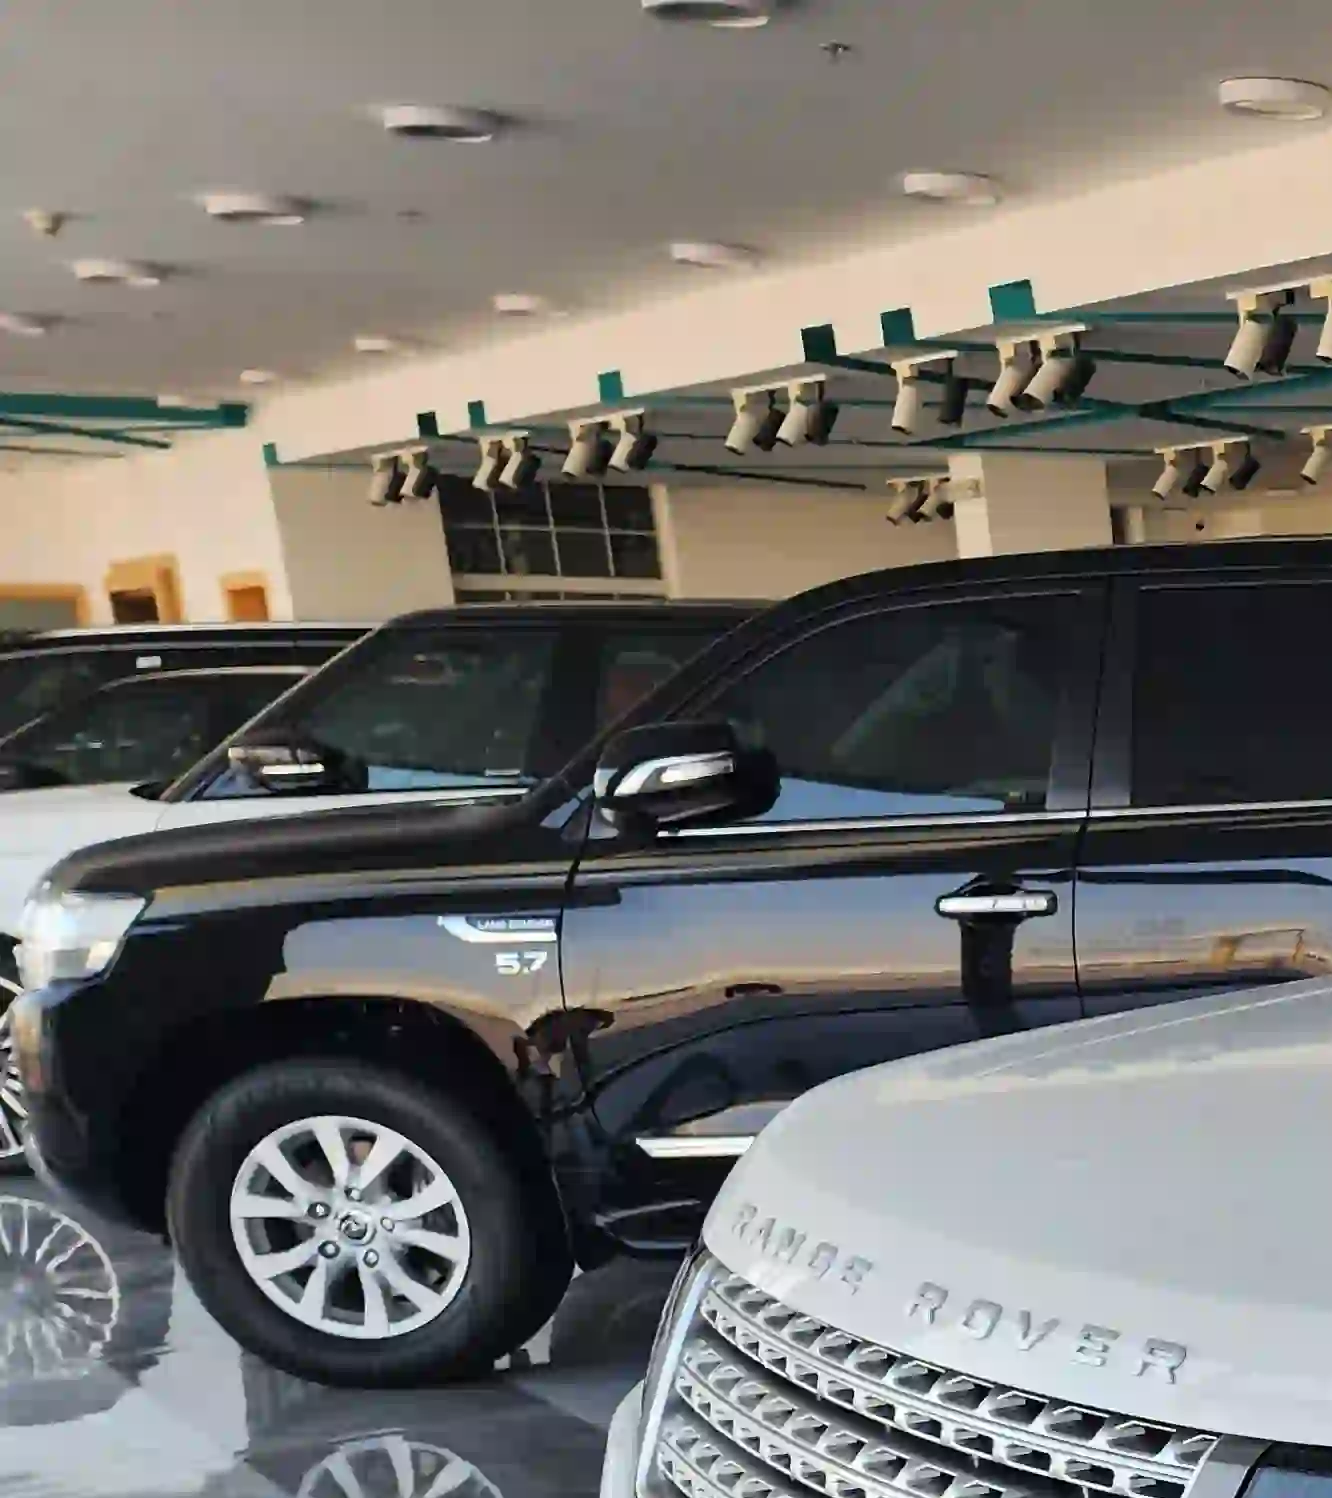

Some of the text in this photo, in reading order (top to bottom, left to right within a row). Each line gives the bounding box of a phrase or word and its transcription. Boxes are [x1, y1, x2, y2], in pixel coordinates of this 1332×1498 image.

[495, 950, 547, 975] 5.7
[731, 1202, 1187, 1385] RANGE ROVER
